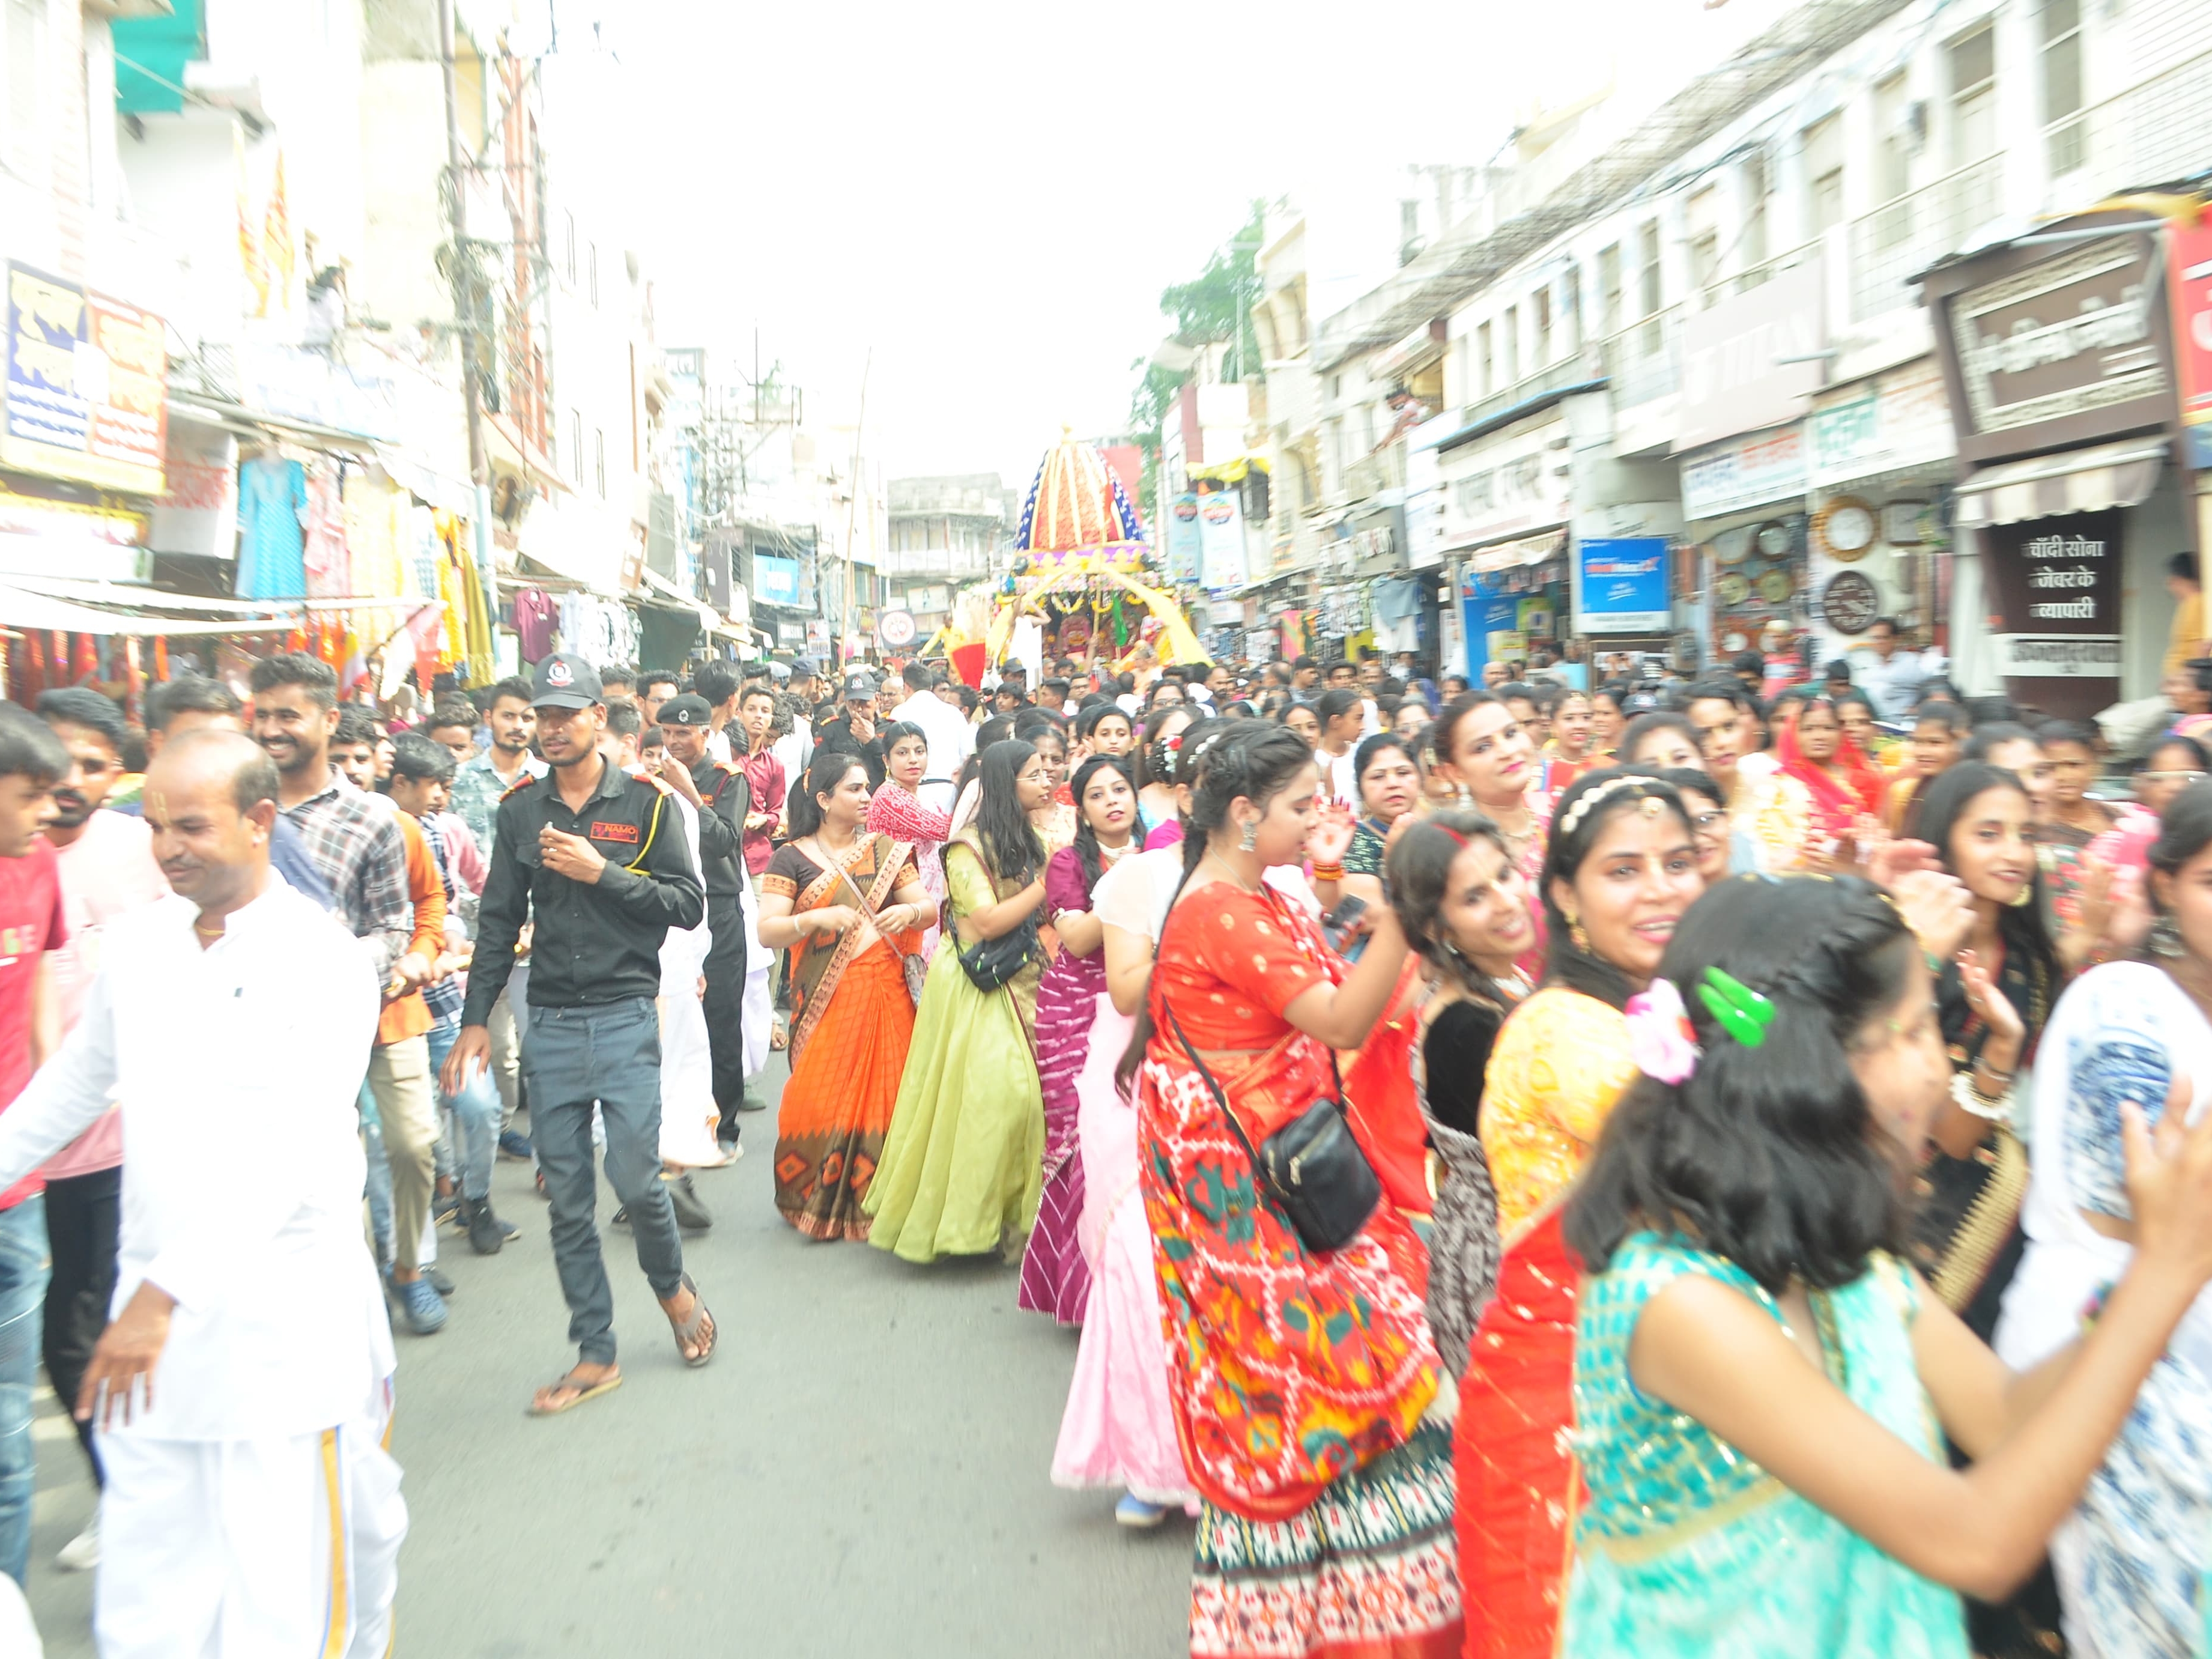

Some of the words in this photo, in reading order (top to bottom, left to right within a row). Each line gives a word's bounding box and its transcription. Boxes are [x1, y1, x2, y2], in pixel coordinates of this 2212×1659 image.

[2029, 535, 2064, 557] चाँदी
[2065, 534, 2104, 556] सोना
[2037, 566, 2076, 587] जेवर
[2076, 565, 2095, 587] के
[2037, 596, 2095, 617] व्यापारी
[604, 825, 636, 835] NAMO
